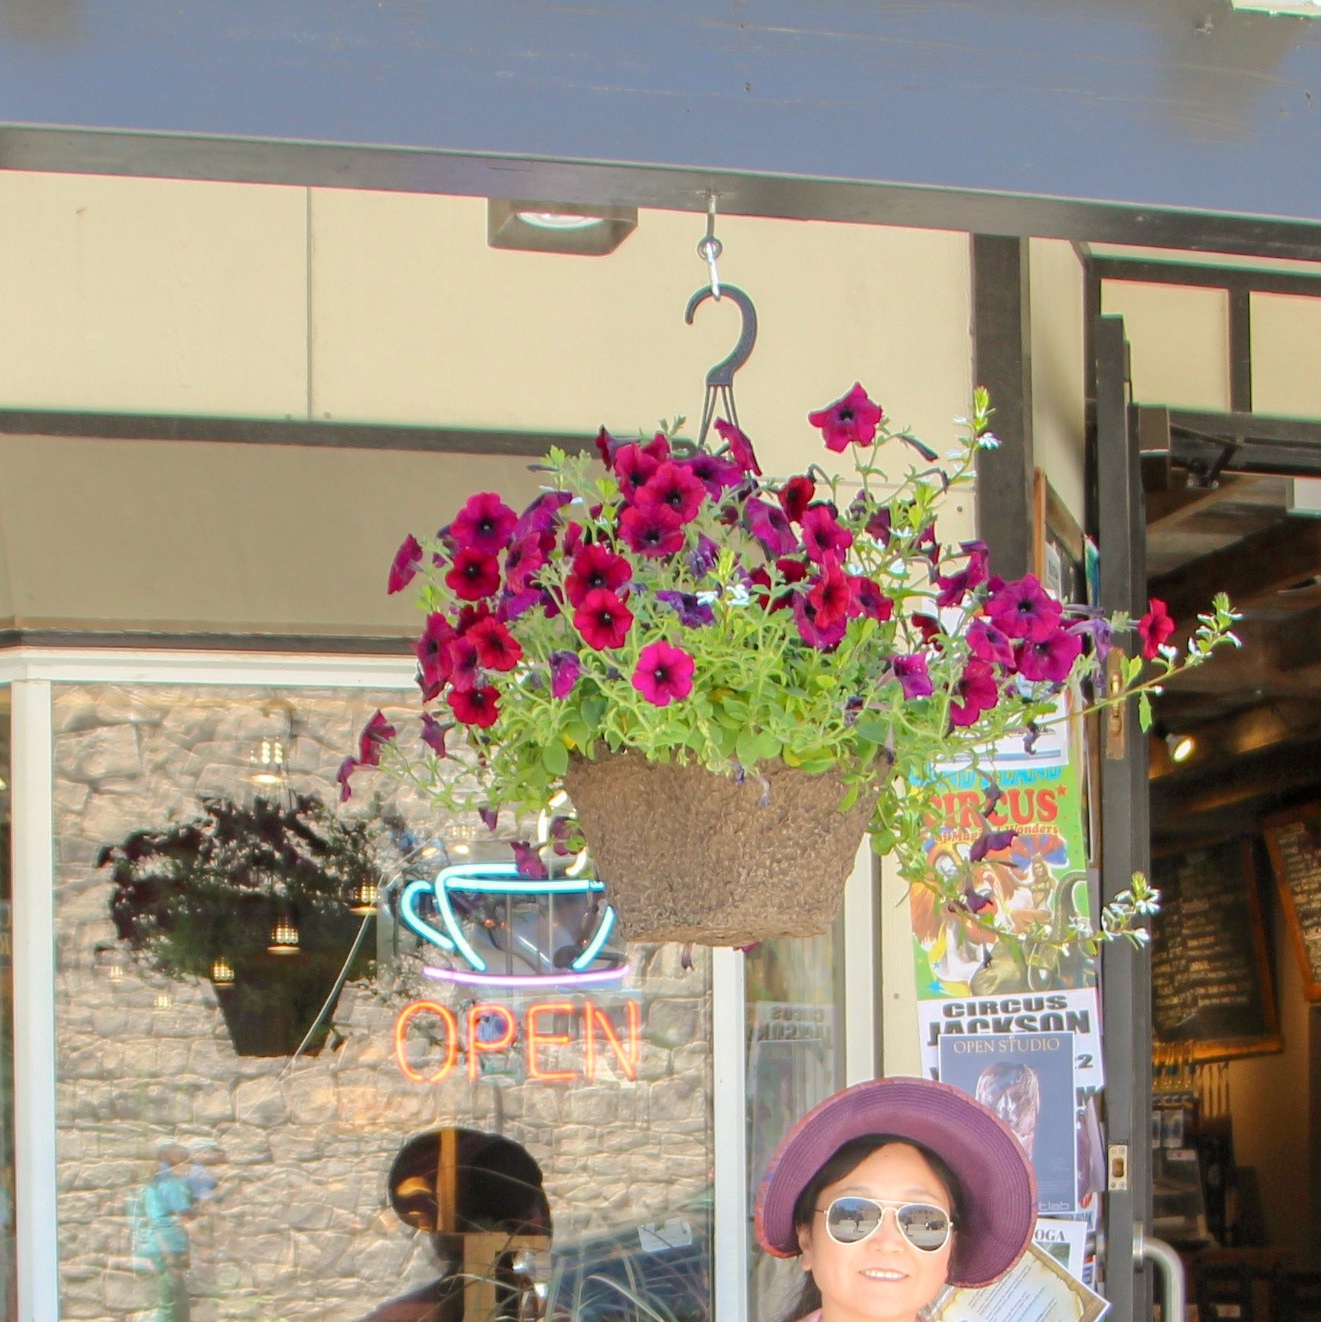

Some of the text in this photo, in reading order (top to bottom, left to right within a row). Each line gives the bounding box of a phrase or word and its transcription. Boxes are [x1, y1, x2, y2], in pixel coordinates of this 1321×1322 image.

[924, 788, 1058, 828] CIRCUS
[943, 994, 1068, 1018] CIRCUS
[393, 999, 642, 1085] OPEN
[927, 1009, 1091, 1047] JACKSON
[953, 1037, 1060, 1054] OPEN STUDIO
